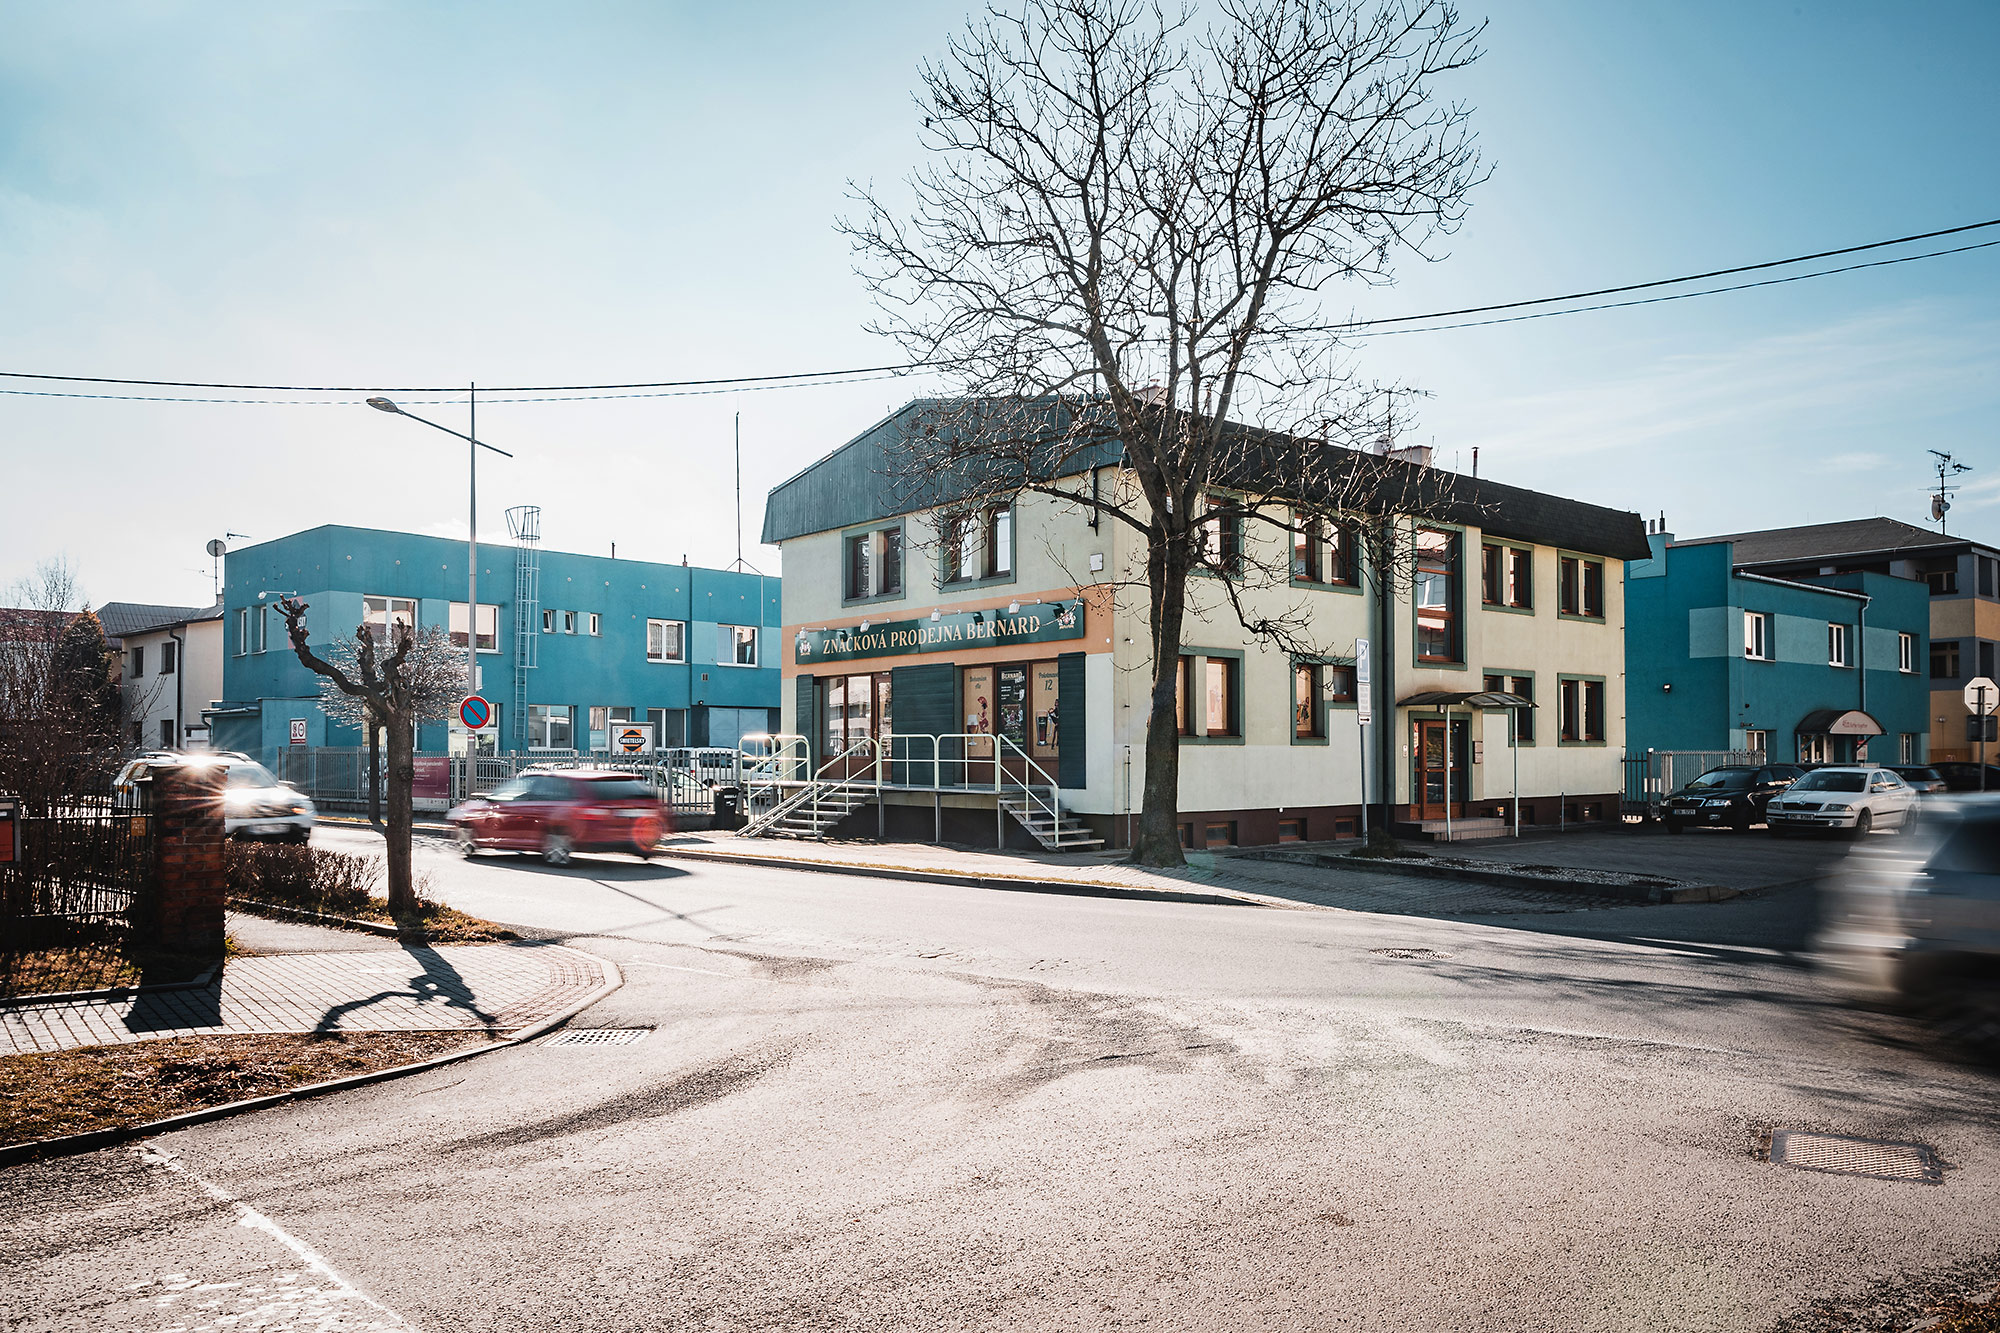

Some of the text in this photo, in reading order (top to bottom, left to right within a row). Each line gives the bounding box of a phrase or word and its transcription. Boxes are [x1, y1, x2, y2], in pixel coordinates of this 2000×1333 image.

[823, 615, 1040, 655] ZNAČKOVÁ PRODEJNA BERNARD
[1044, 679, 1053, 690] 12
